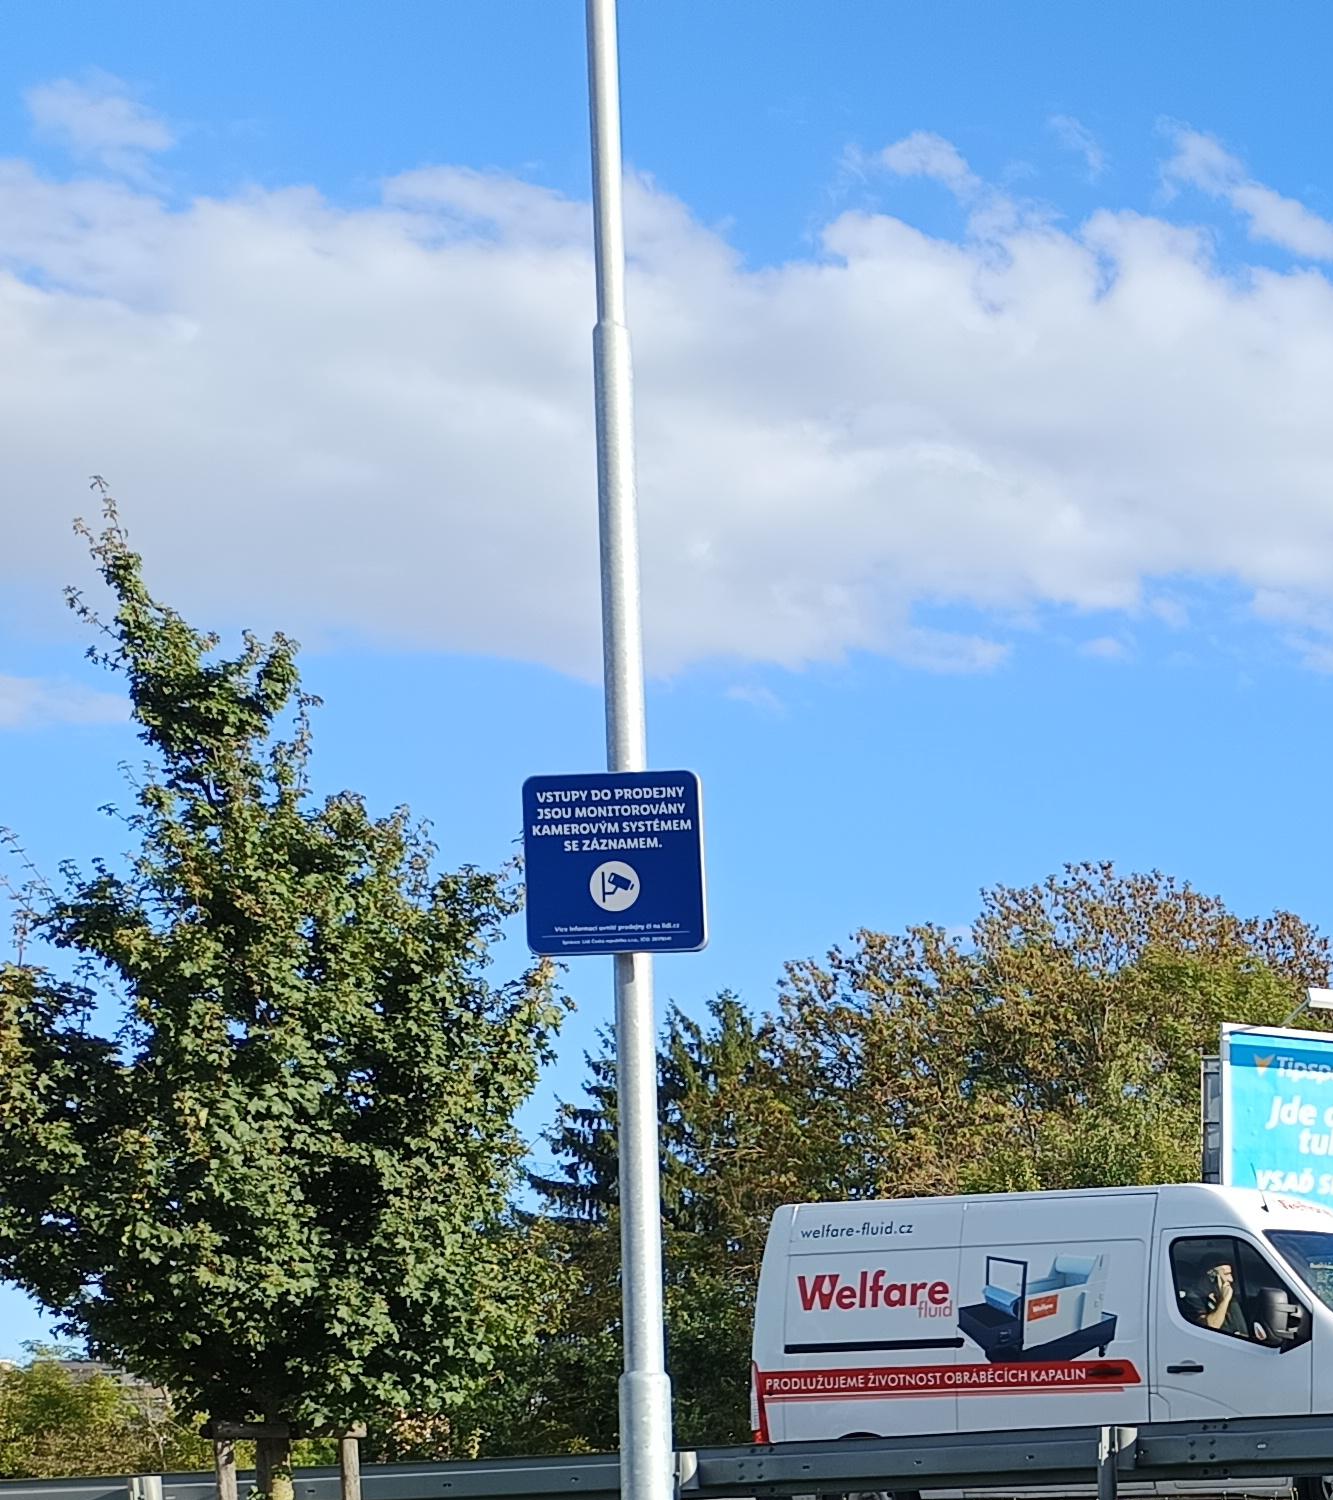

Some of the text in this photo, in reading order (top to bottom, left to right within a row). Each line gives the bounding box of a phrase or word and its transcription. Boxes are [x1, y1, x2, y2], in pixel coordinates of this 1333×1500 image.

[536, 786, 685, 803] VSTUPY DO PRODEJNY
[537, 802, 686, 820] JSOU MONITOROVÁNY
[532, 818, 692, 836] KAMEROVÝM SYSTÉMEM
[564, 840, 580, 852] SE
[1265, 1094, 1317, 1130] Jde
[801, 1221, 914, 1239] welfare-fluid.cz
[797, 1269, 950, 1311] Welfare
[917, 1300, 953, 1319] fluid
[765, 1367, 1086, 1391] PRODLUŽUJEME ŽIVOTNOST OBRÁBĚCÍCH KAPALIN
